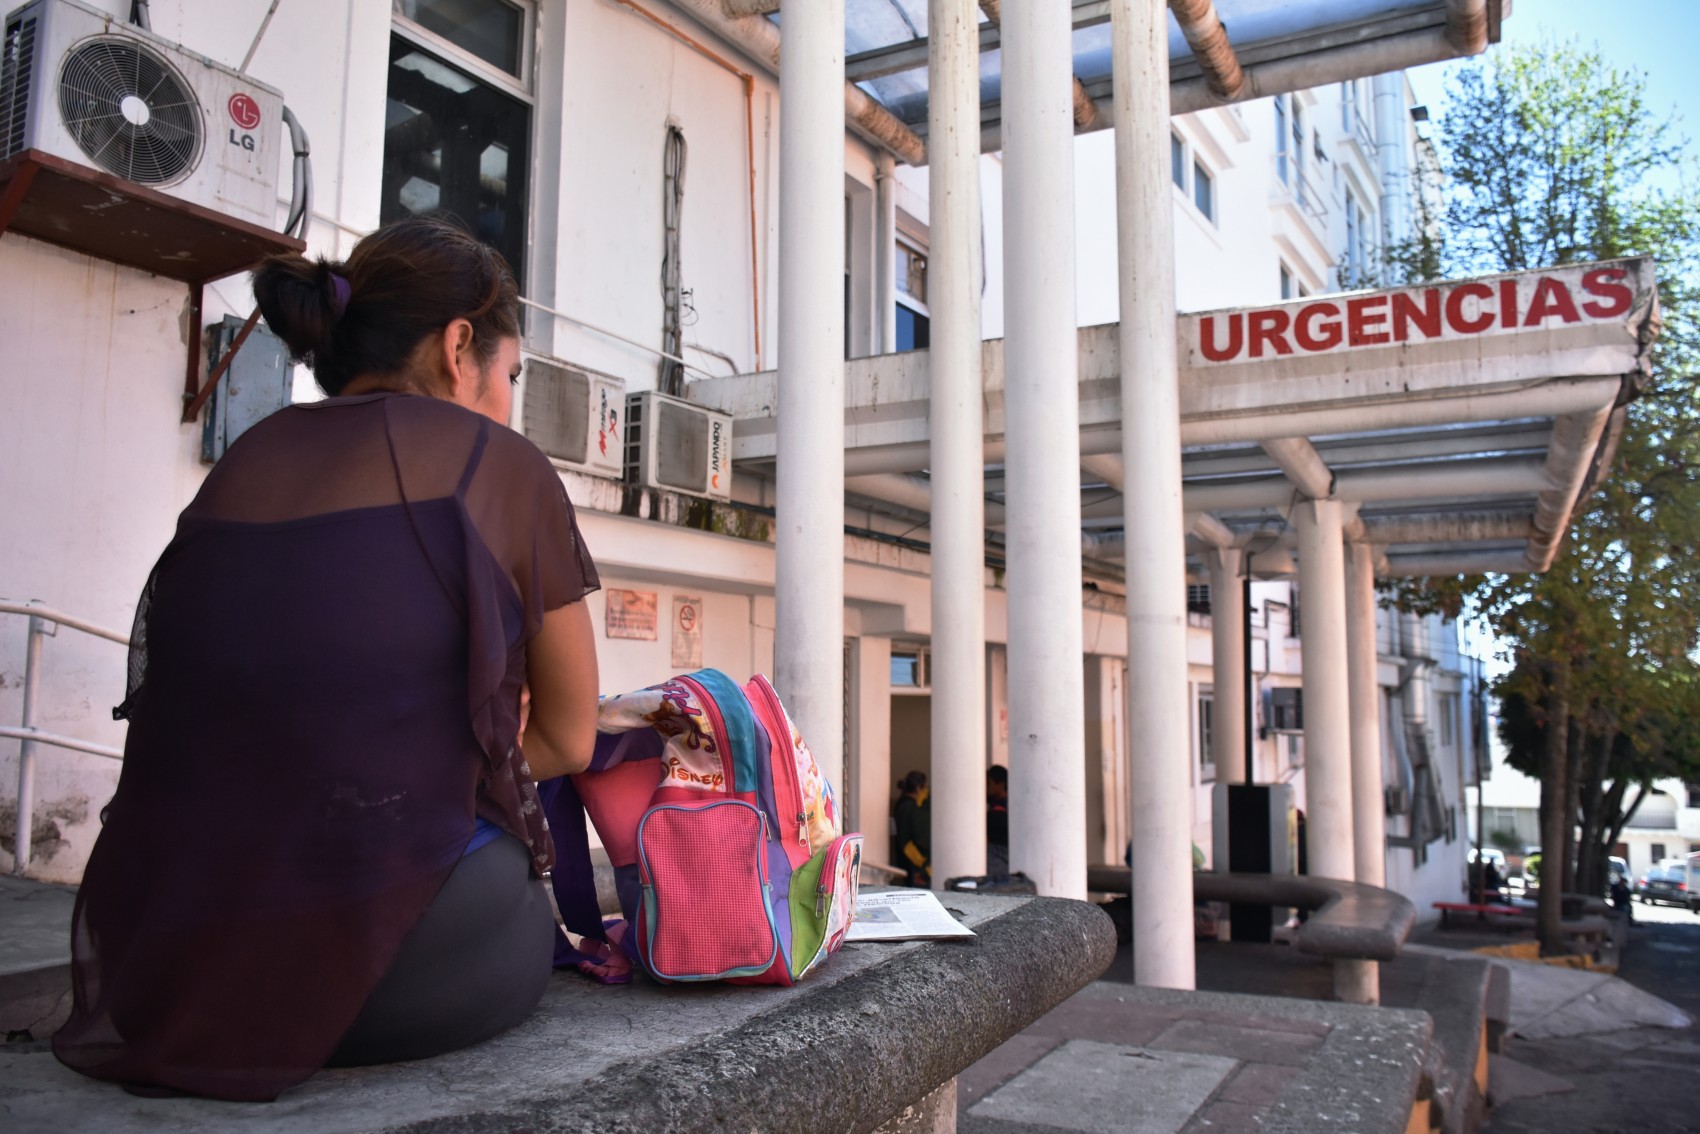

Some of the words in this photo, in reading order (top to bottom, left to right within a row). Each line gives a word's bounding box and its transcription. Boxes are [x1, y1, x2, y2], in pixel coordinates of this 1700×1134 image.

[229, 128, 254, 152] LG
[1200, 269, 1633, 362] URGENCIAS
[711, 421, 721, 473] JAPANDO
